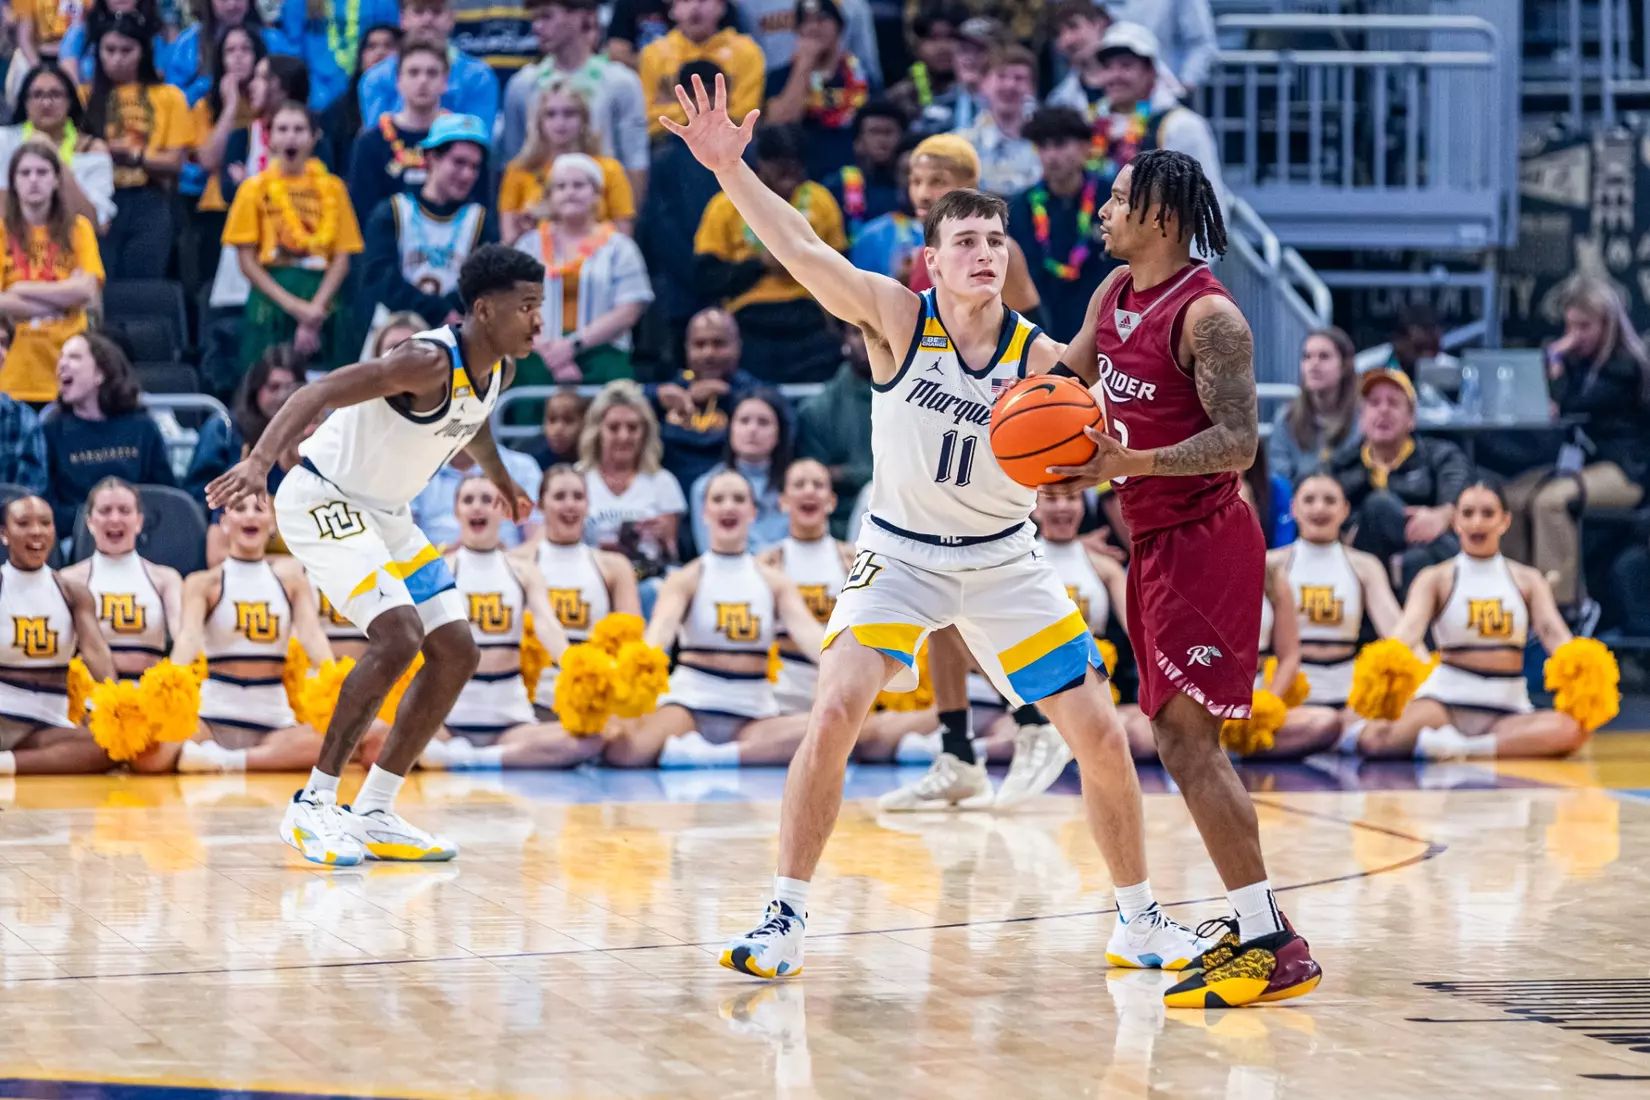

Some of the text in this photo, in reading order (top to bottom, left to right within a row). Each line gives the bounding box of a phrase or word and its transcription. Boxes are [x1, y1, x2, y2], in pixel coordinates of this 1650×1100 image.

[935, 429, 977, 487] 11
[310, 500, 366, 540] MU
[100, 593, 146, 633] MU
[234, 602, 280, 642] MU
[467, 593, 512, 632] MU
[716, 602, 760, 641] MU
[1300, 586, 1343, 625] MU
[1467, 599, 1513, 638] MU
[12, 616, 58, 657] MU
